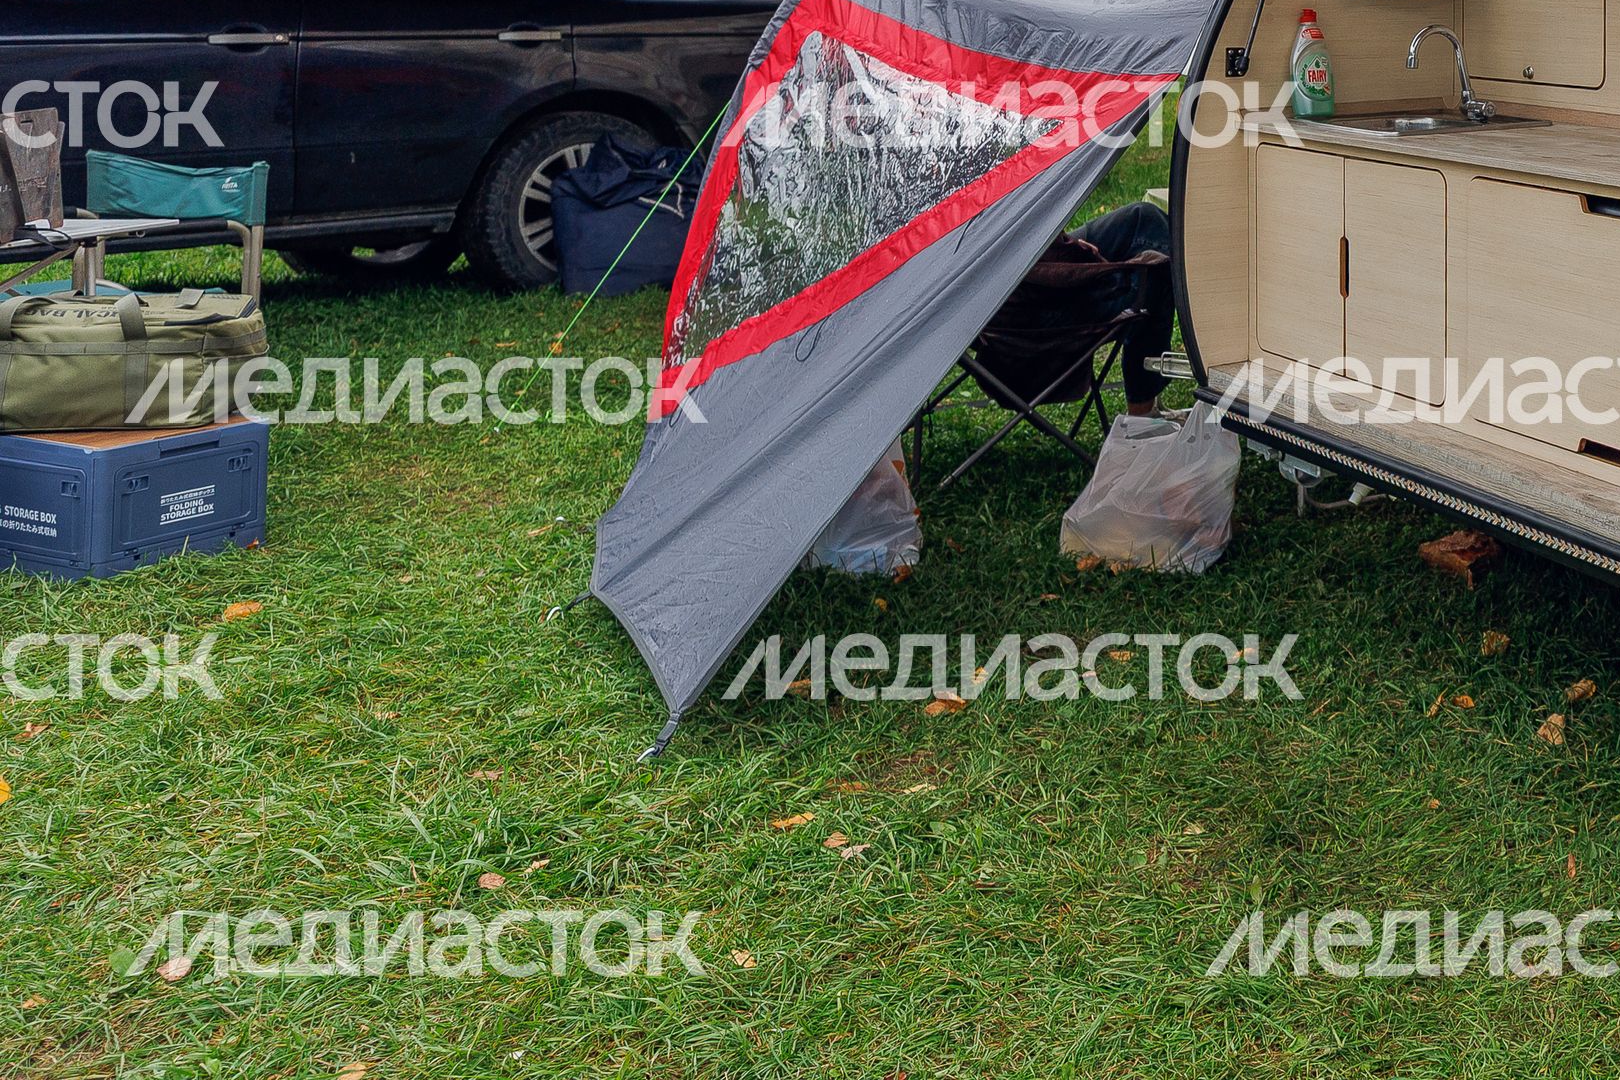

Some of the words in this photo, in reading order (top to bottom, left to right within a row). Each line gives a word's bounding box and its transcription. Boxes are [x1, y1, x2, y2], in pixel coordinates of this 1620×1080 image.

[1307, 70, 1327, 83] FAIRY
[160, 508, 198, 522] STORAGE
[197, 503, 214, 514] BOX
[169, 498, 204, 512] FOLDING
[4, 505, 39, 521] STORAGE
[40, 512, 57, 524] BOX
